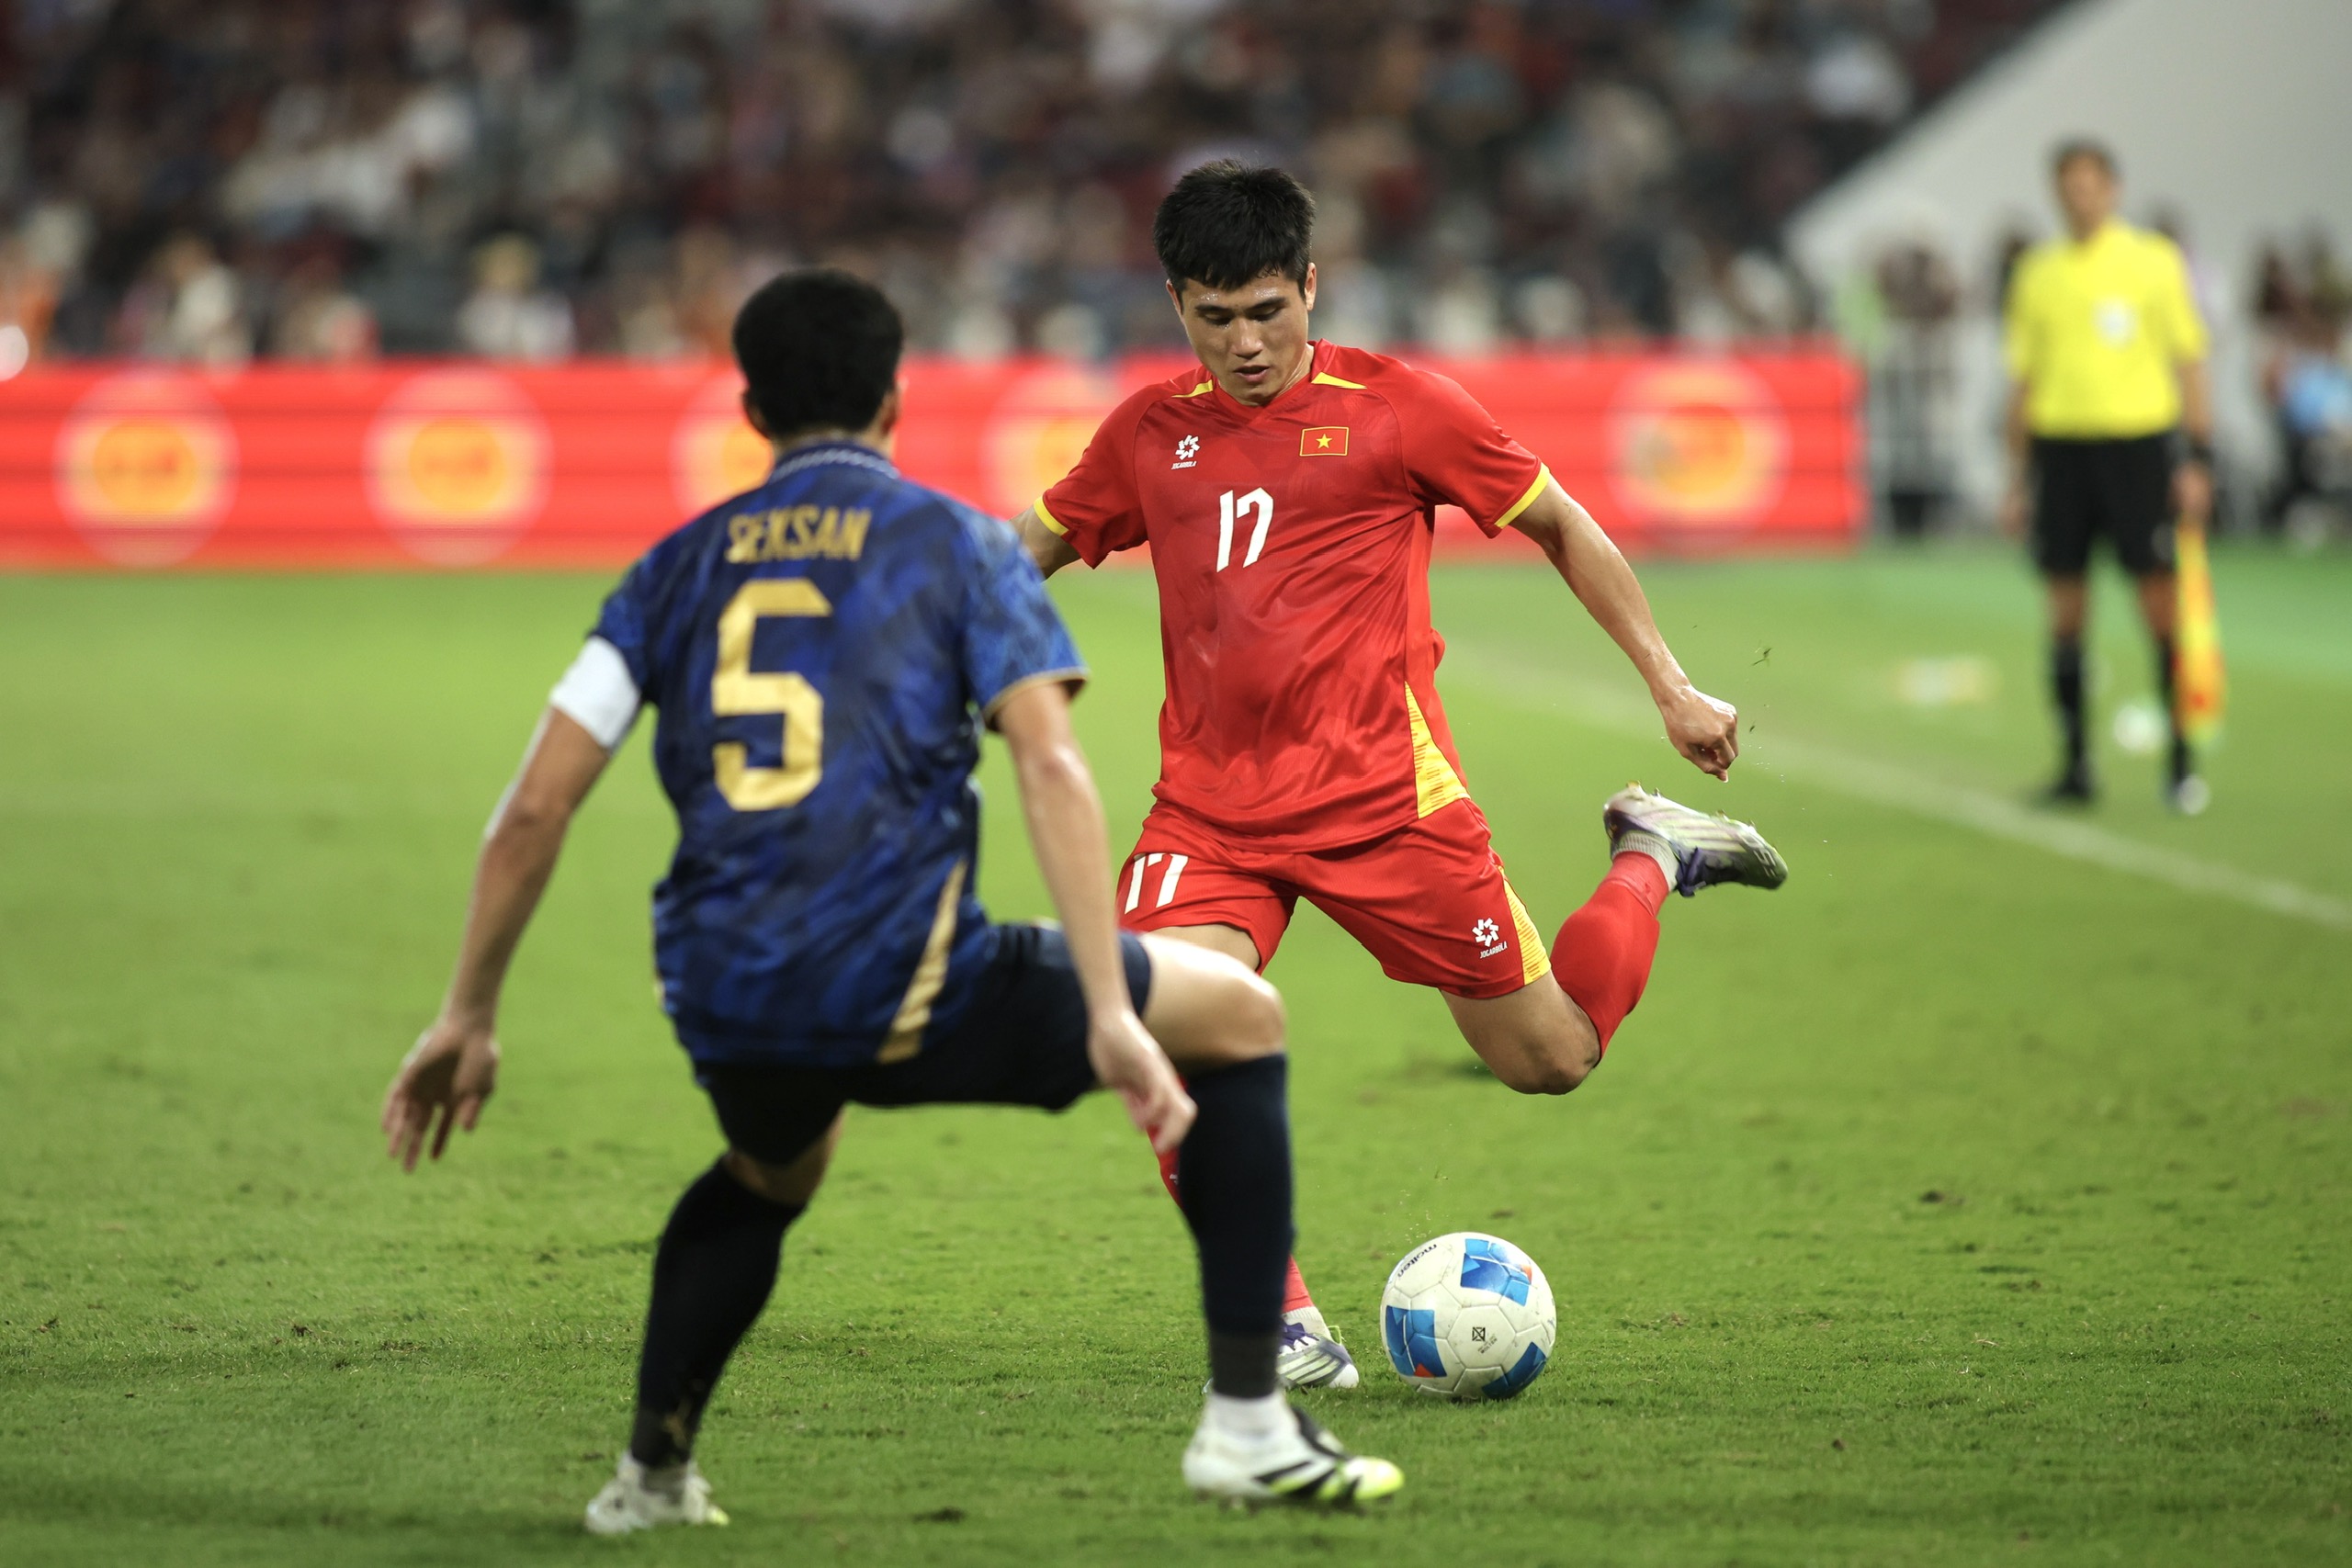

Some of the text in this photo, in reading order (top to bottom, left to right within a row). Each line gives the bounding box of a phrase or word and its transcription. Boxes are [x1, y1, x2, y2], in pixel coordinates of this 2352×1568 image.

[725, 504, 872, 564] SEKSAN
[1216, 487, 1273, 572] 17
[711, 577, 832, 811] 5
[1124, 852, 1189, 915] 17
[1397, 1244, 1437, 1278] molten
